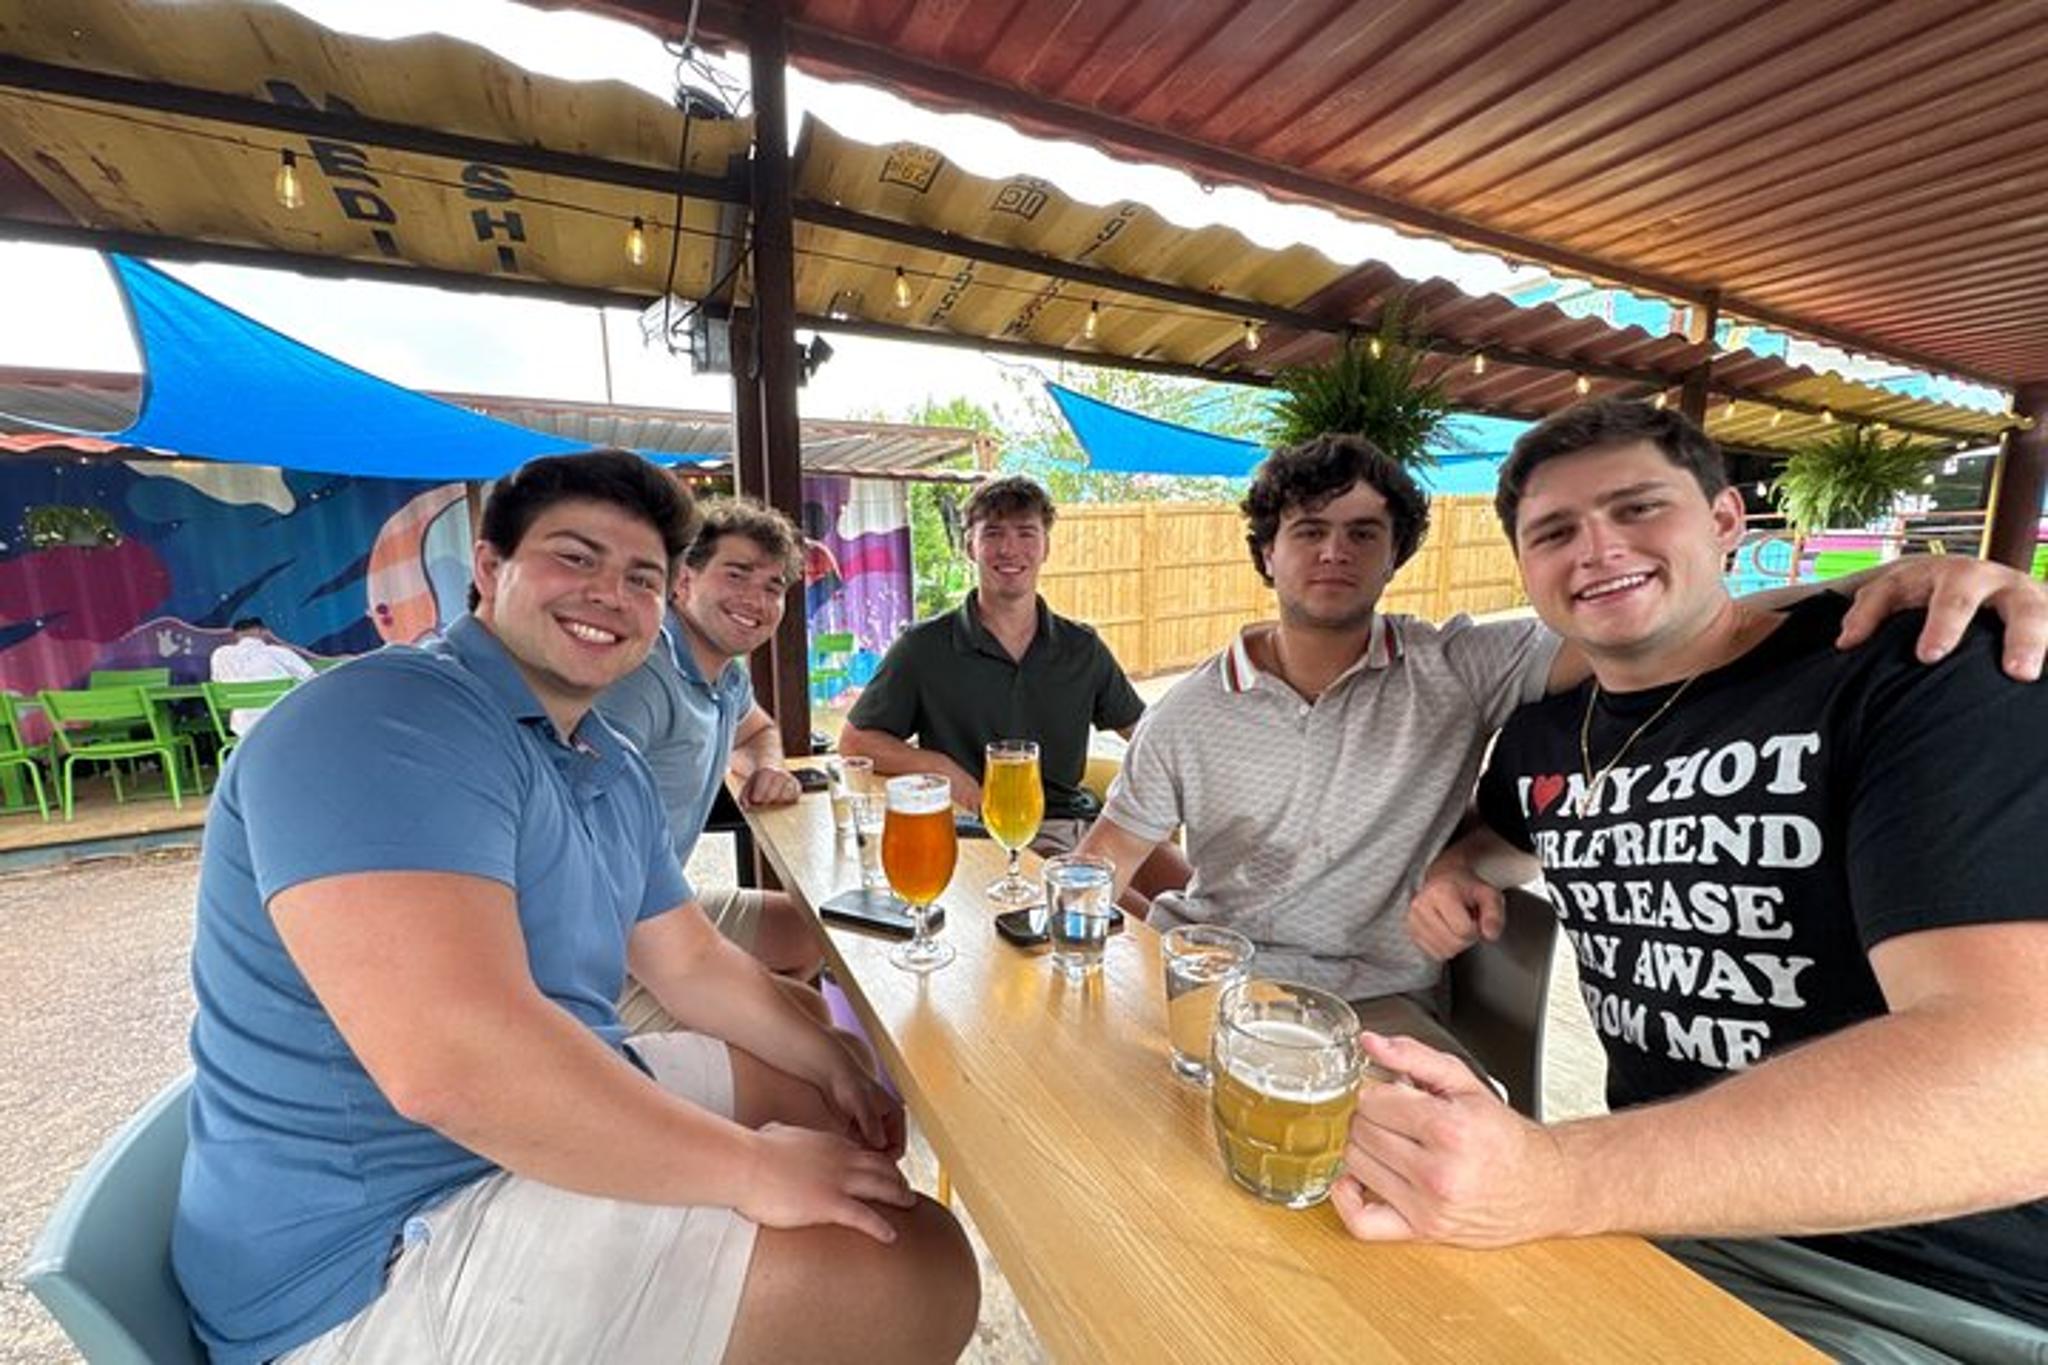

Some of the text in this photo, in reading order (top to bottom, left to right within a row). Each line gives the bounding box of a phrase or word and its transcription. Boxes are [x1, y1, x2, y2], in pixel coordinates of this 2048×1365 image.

[462, 163, 526, 271] SHI
[1556, 764, 1651, 817] MY
[1647, 732, 1821, 802] HOT
[1531, 814, 1822, 868] IRLFRIEND
[1567, 880, 1793, 940] PLEASE
[1633, 939, 1815, 1008] AWAY
[1581, 982, 1770, 1071] ROM ME
